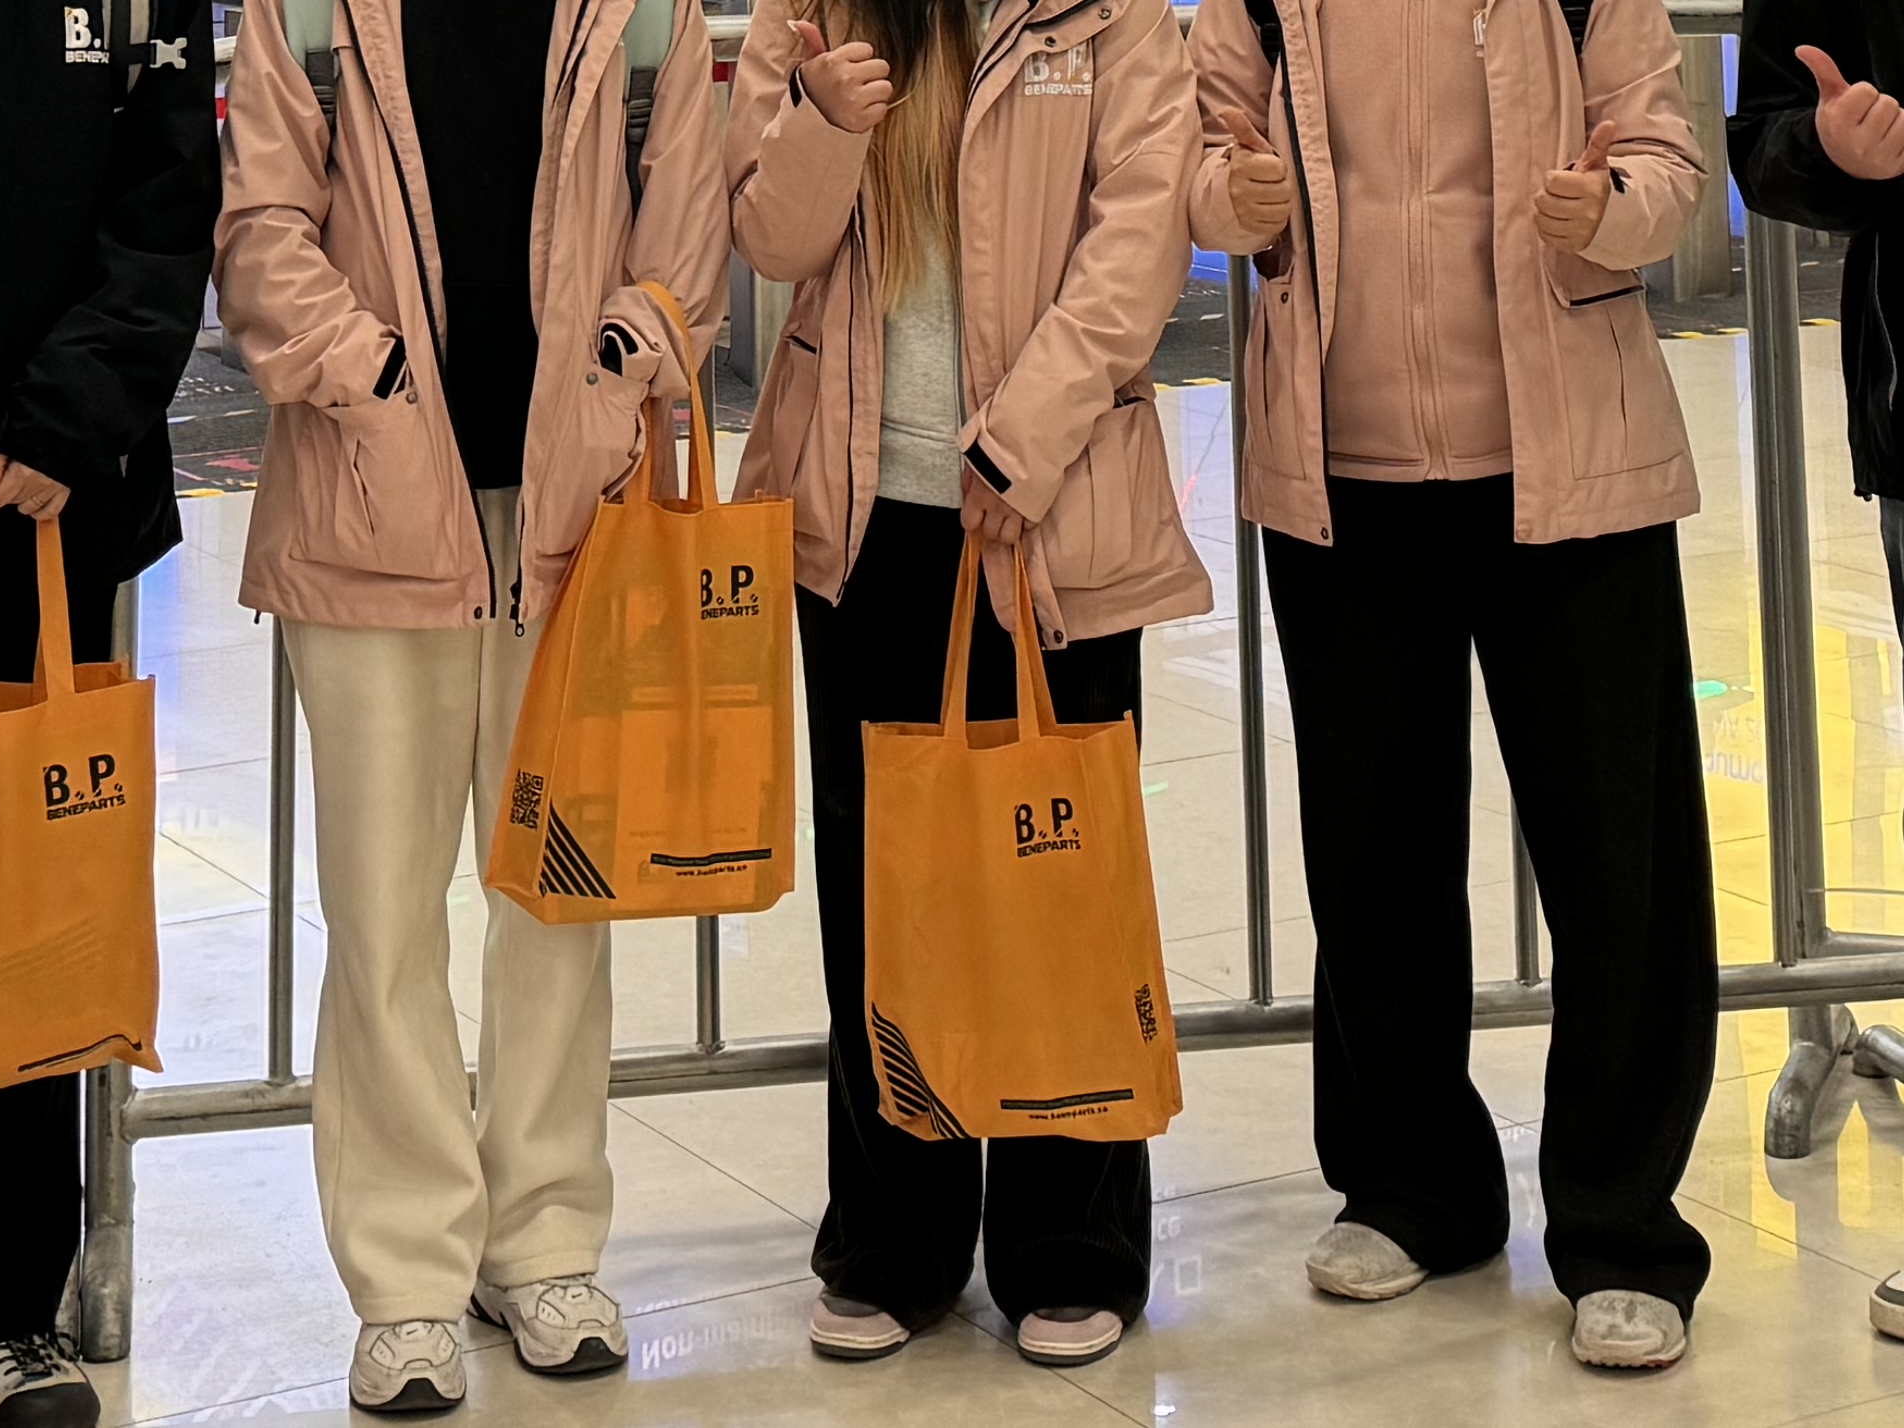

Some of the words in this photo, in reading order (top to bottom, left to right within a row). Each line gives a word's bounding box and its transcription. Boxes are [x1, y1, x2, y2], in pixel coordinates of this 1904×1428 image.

[42, 753, 123, 808] B.P.
[46, 794, 127, 821] BENEPARTS
[1014, 797, 1079, 845] B.P.
[1017, 839, 1081, 858] BENEPARTS
